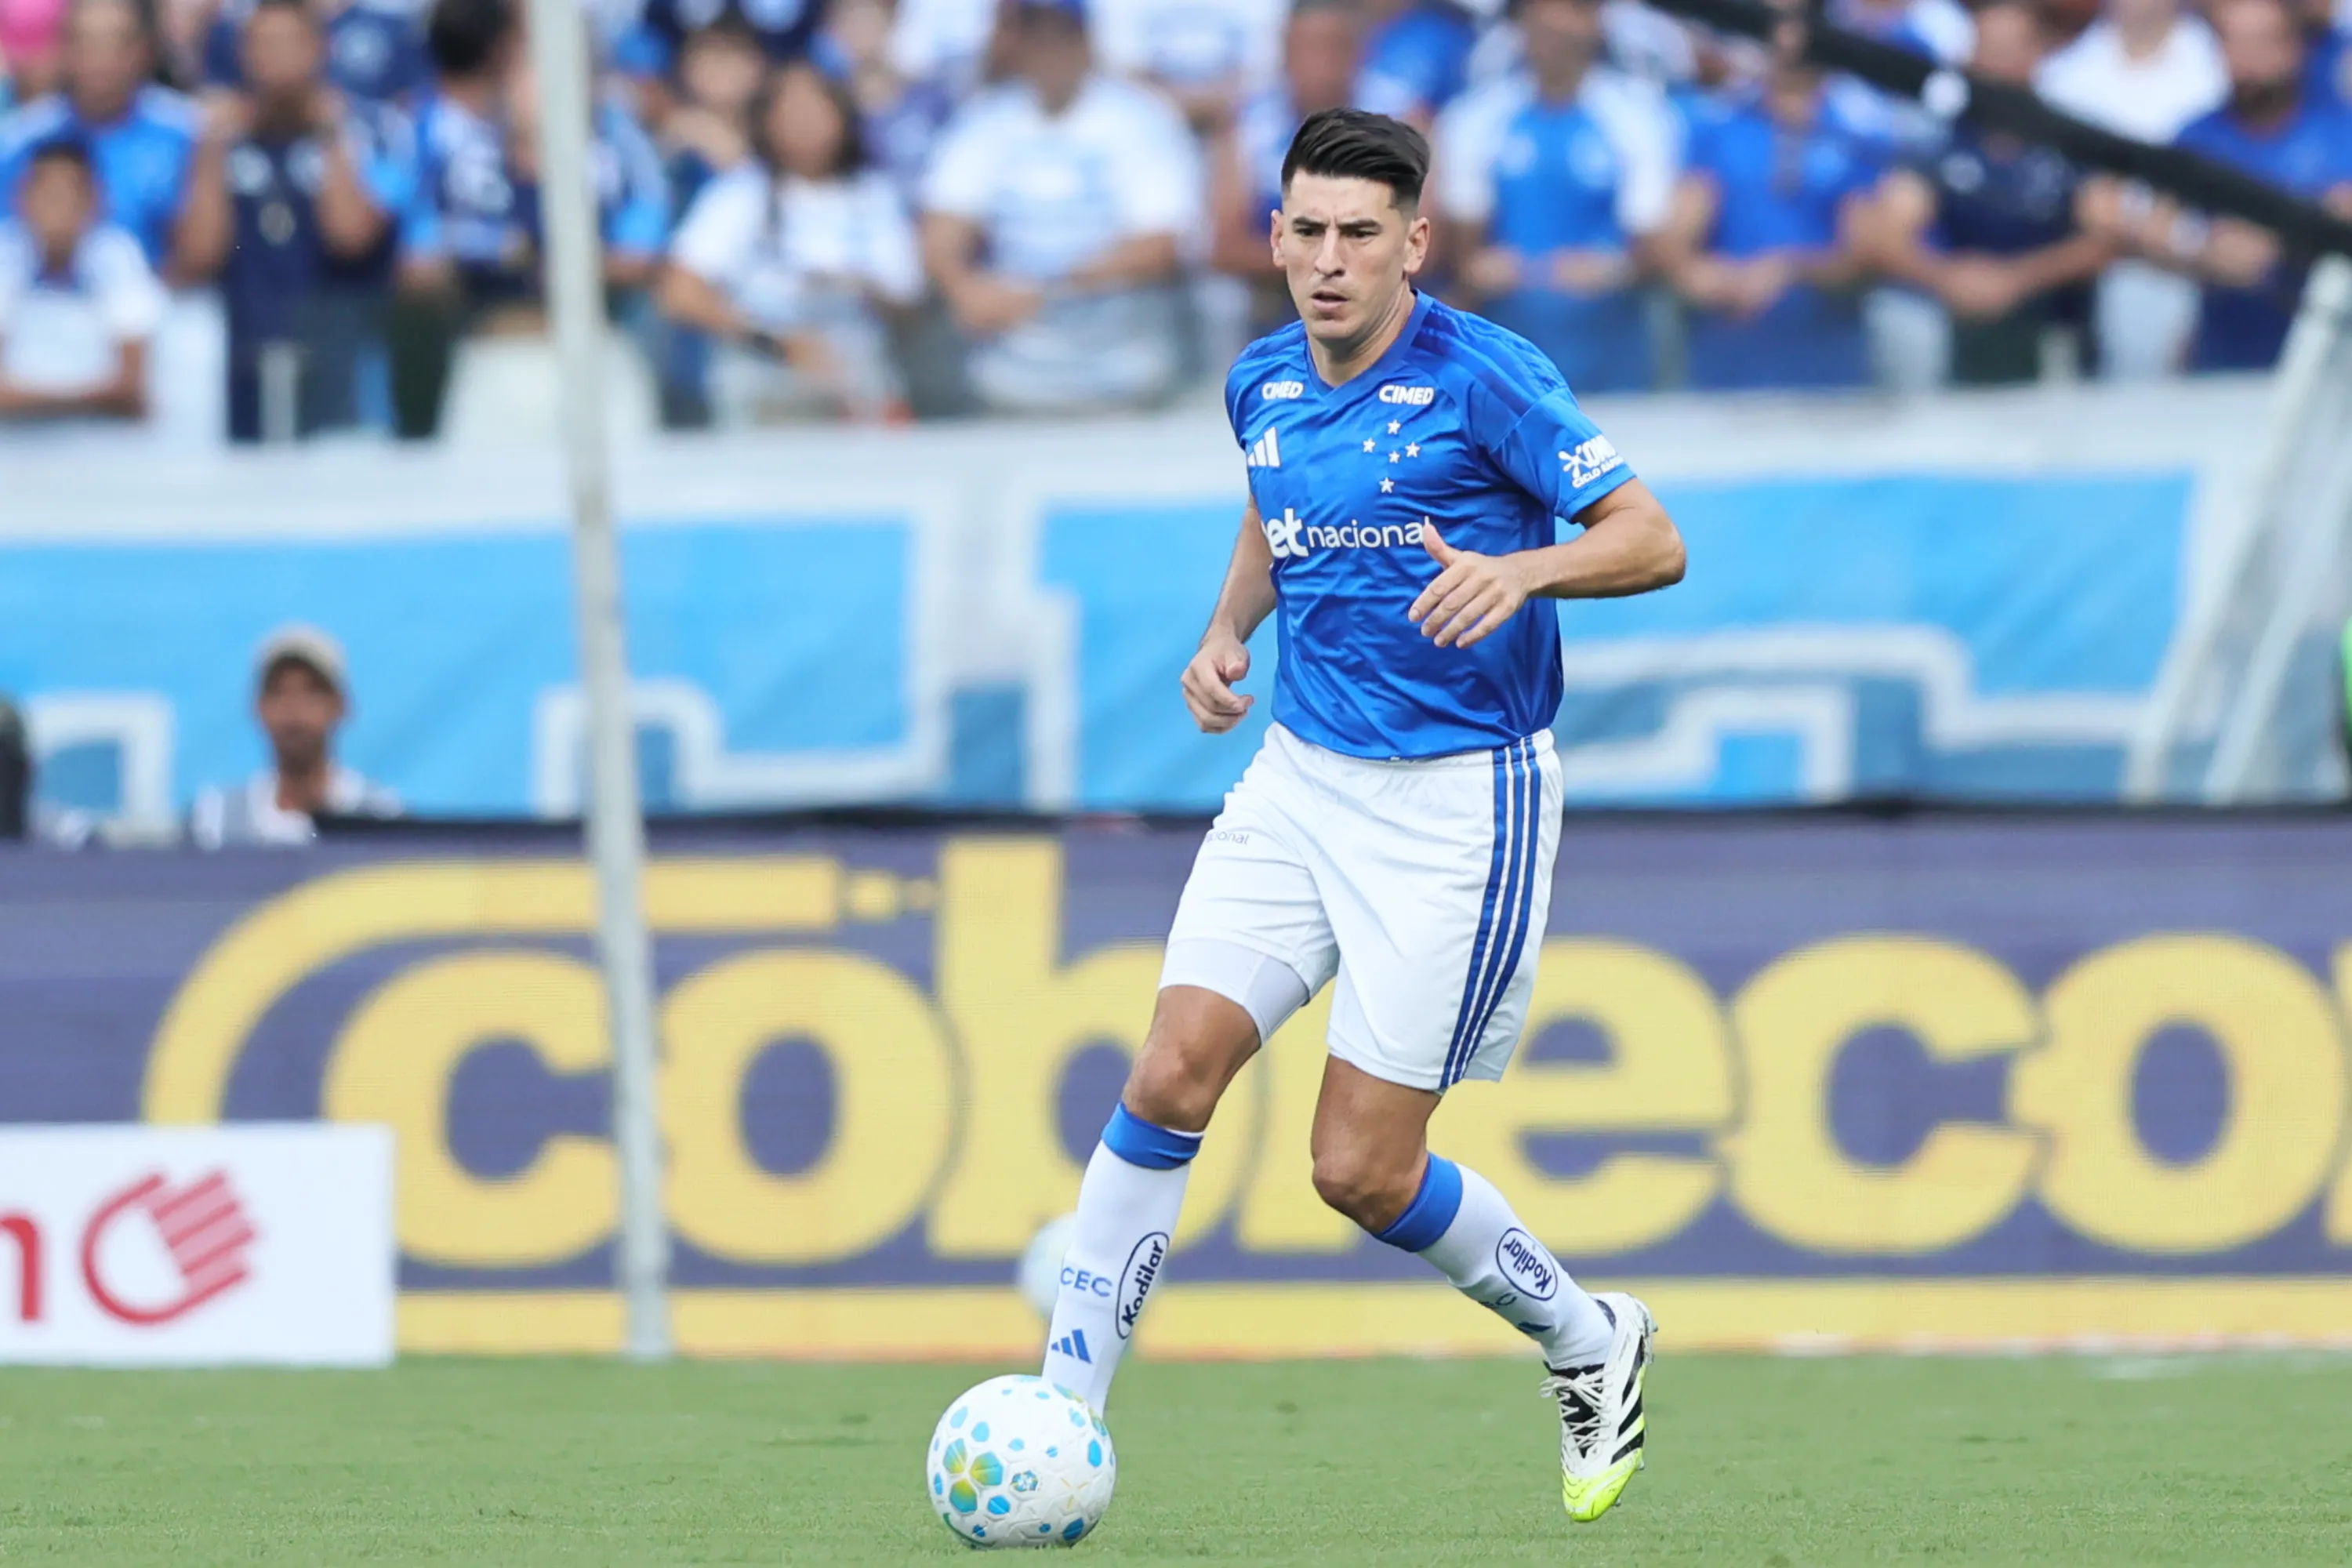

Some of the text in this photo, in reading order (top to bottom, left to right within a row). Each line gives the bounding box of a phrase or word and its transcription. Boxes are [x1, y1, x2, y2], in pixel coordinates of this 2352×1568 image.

[1378, 385, 1434, 405] CIMED
[1060, 1266, 1113, 1297] CEC
[1121, 1240, 1163, 1327] Kodilar
[1503, 1237, 1552, 1294] Kodilar
